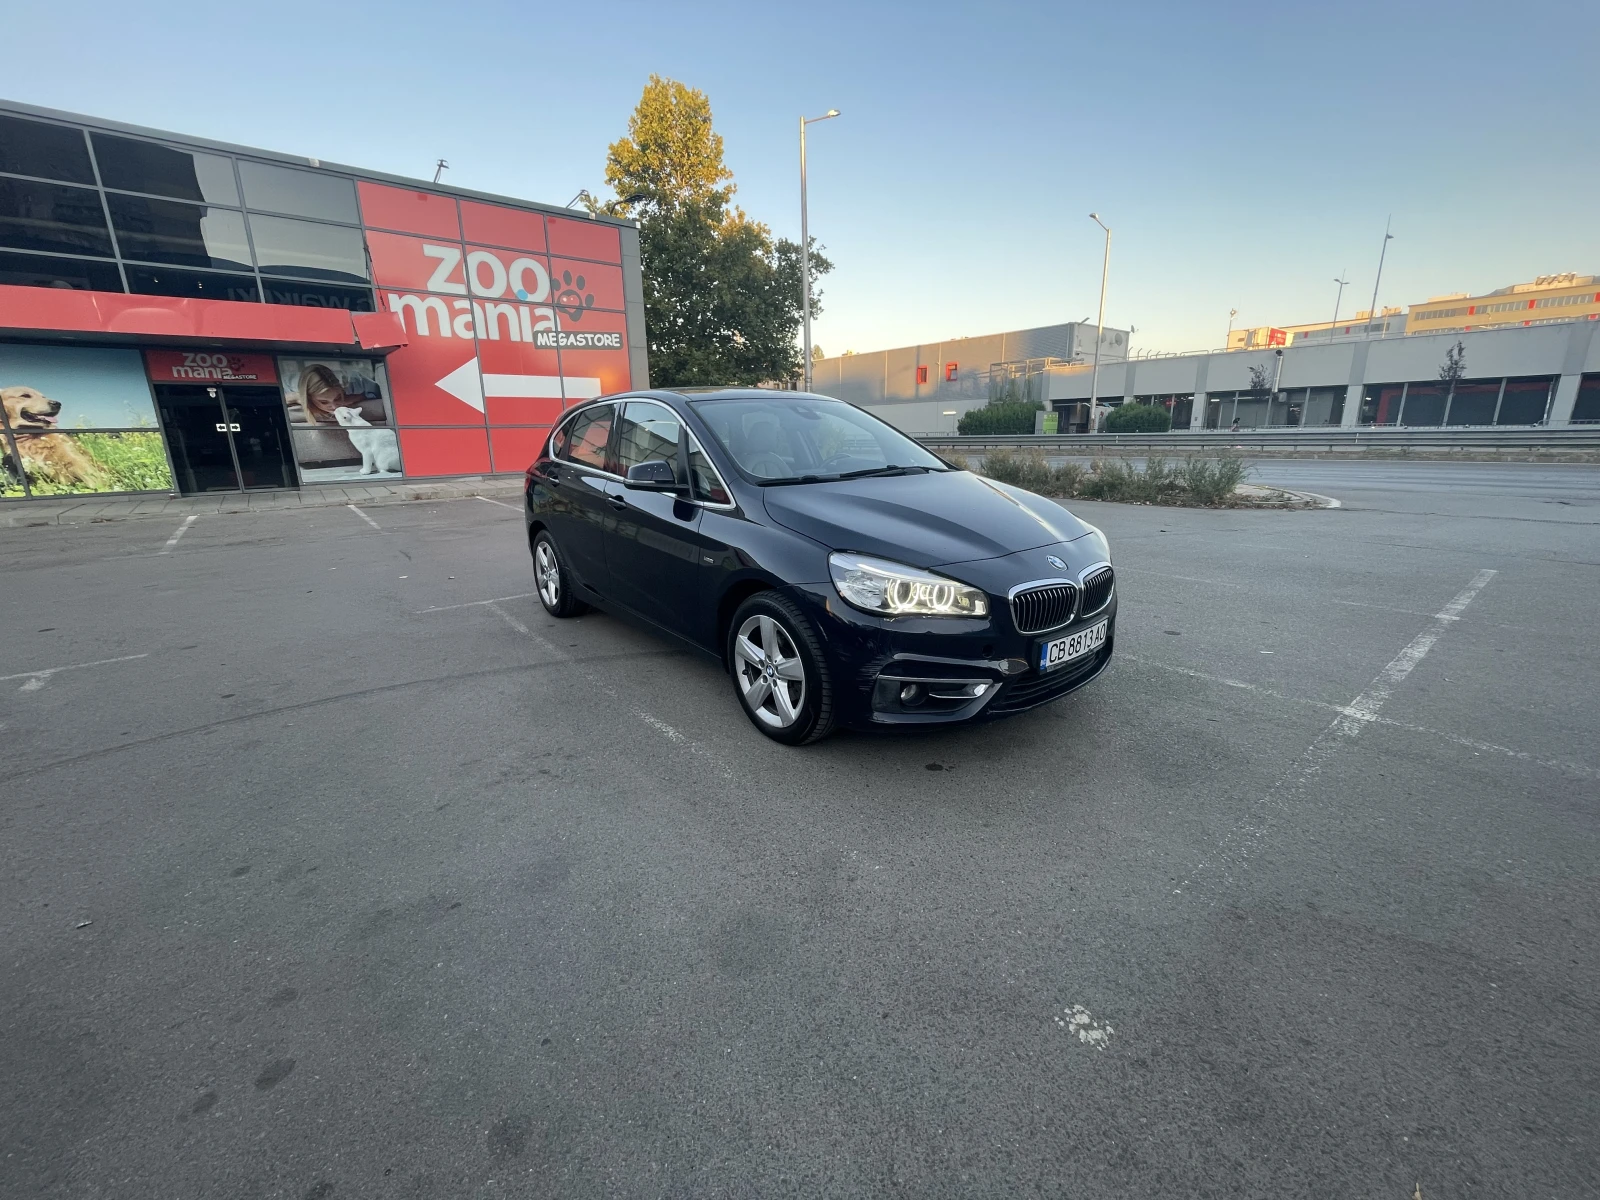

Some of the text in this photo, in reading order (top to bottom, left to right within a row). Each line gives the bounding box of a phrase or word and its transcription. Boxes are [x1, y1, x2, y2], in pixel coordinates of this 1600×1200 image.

[387, 293, 561, 343] mania
[537, 332, 621, 347] MEGASTORE
[172, 366, 233, 379] mania
[1049, 641, 1066, 663] CB
[1068, 629, 1094, 657] 8813
[1094, 623, 1106, 644] AO
